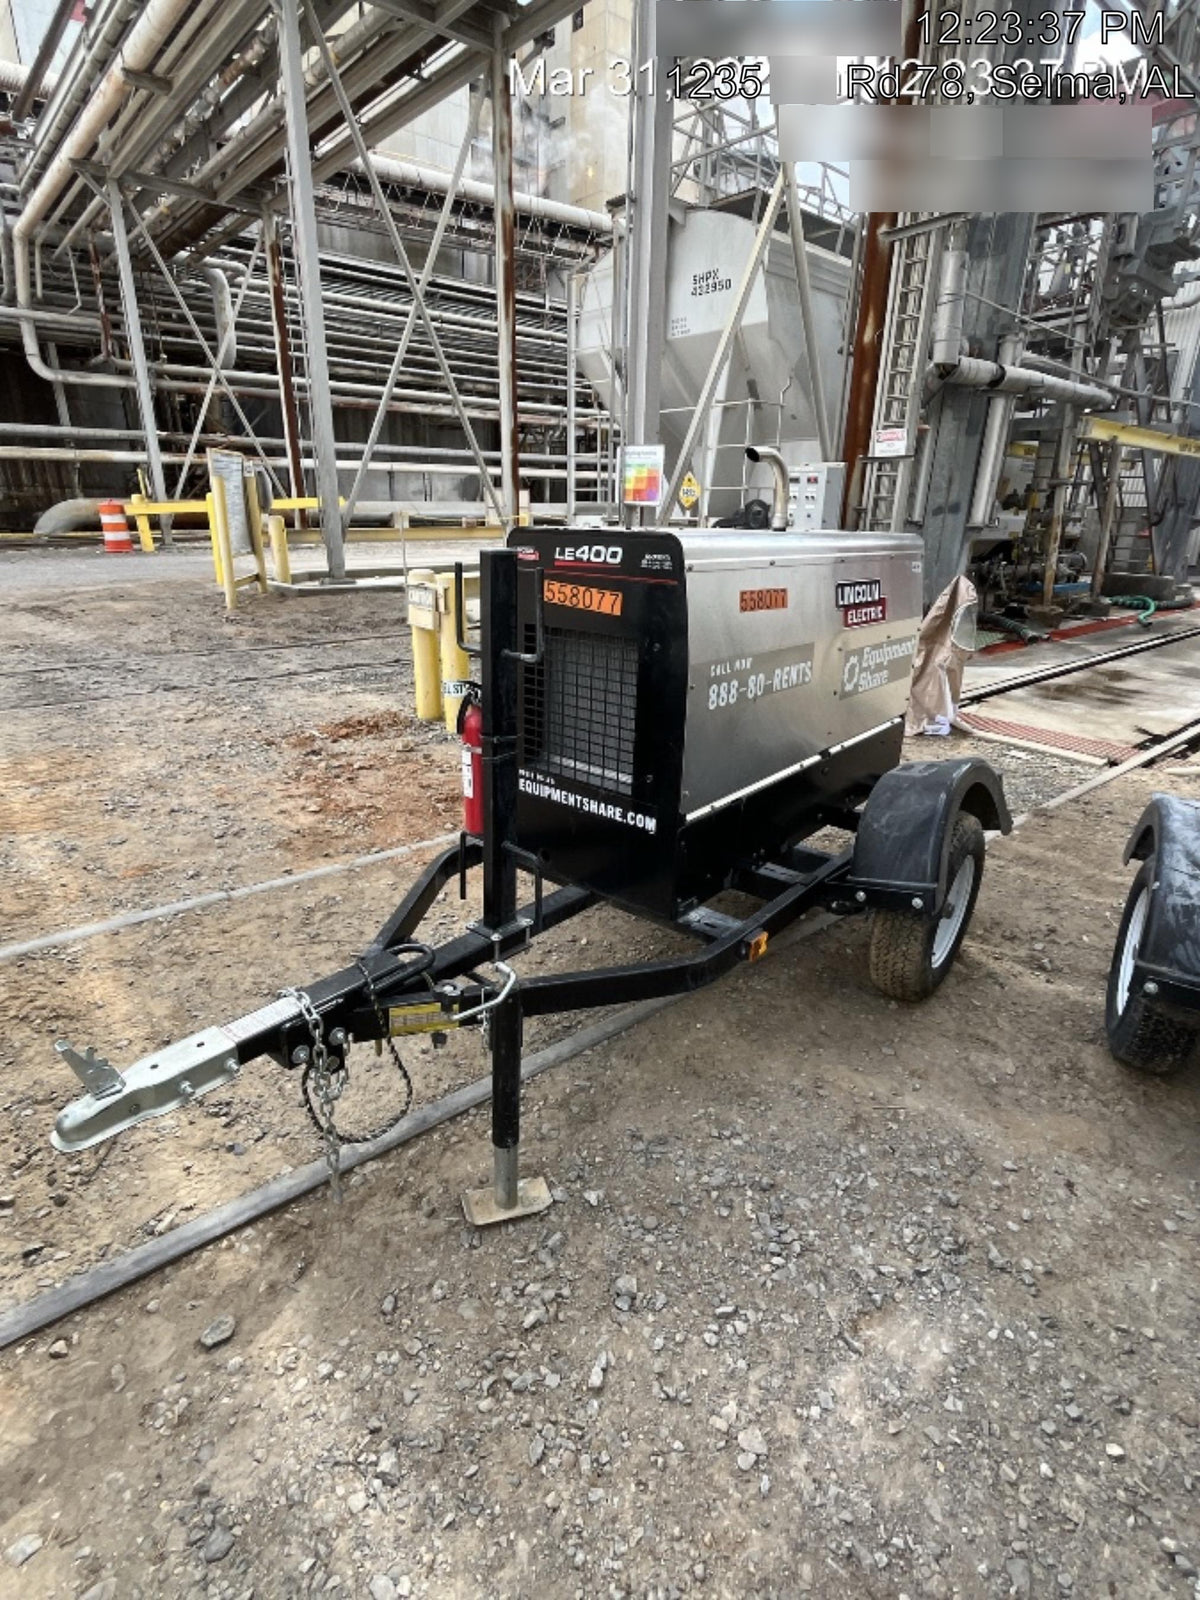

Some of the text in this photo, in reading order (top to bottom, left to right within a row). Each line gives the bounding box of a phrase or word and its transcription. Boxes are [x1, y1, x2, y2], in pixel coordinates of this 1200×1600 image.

[692, 268, 719, 285] SHPX
[554, 545, 623, 564] LE400
[544, 582, 620, 614] 558077
[740, 588, 788, 612] 558077
[838, 583, 880, 606] LINCOLN
[847, 606, 884, 625] ELECTRIC
[708, 660, 812, 711] 888-80-RENTS
[858, 669, 889, 692] Share
[518, 778, 657, 833] EQUIPMENTSHARE.COM
